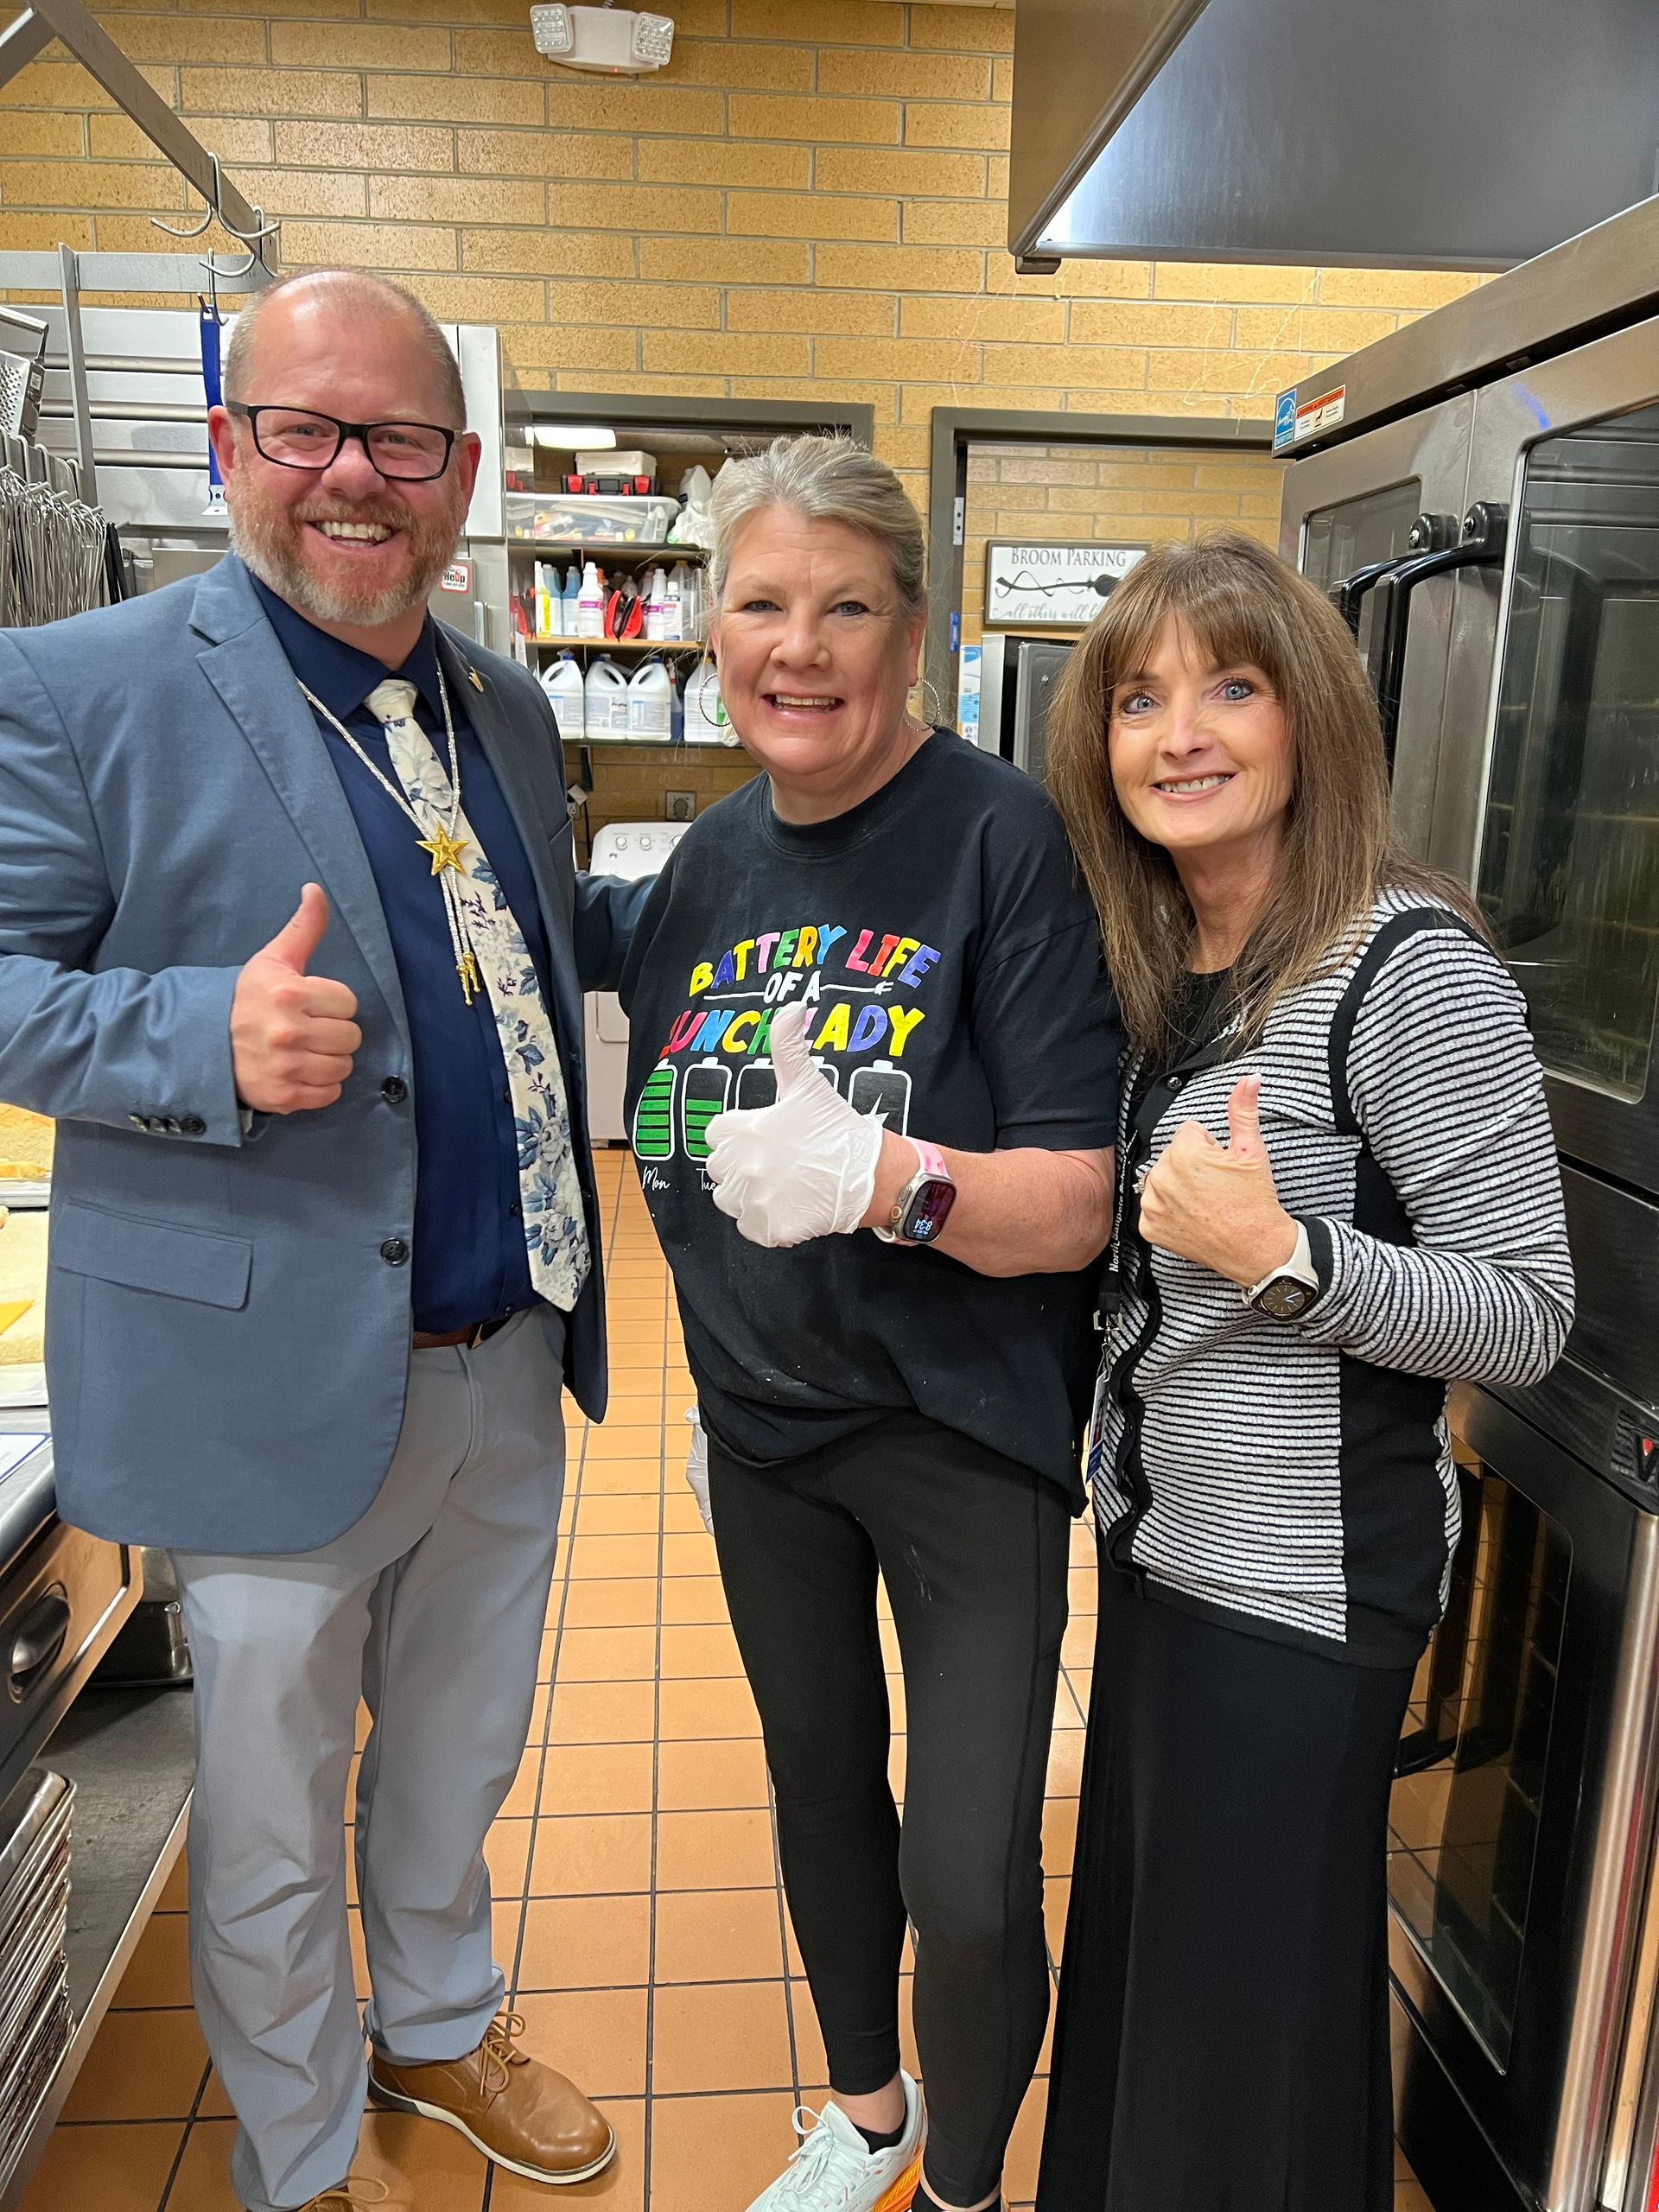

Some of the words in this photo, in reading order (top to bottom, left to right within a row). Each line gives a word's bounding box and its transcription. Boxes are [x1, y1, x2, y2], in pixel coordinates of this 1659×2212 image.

[1012, 546, 1062, 565] BROOM
[1066, 547, 1127, 567] PARKING
[689, 923, 847, 997] BATTERY
[844, 928, 942, 988] LIFE
[763, 970, 804, 1004] OF
[801, 969, 822, 1004] A
[642, 1166, 671, 1191] Mon
